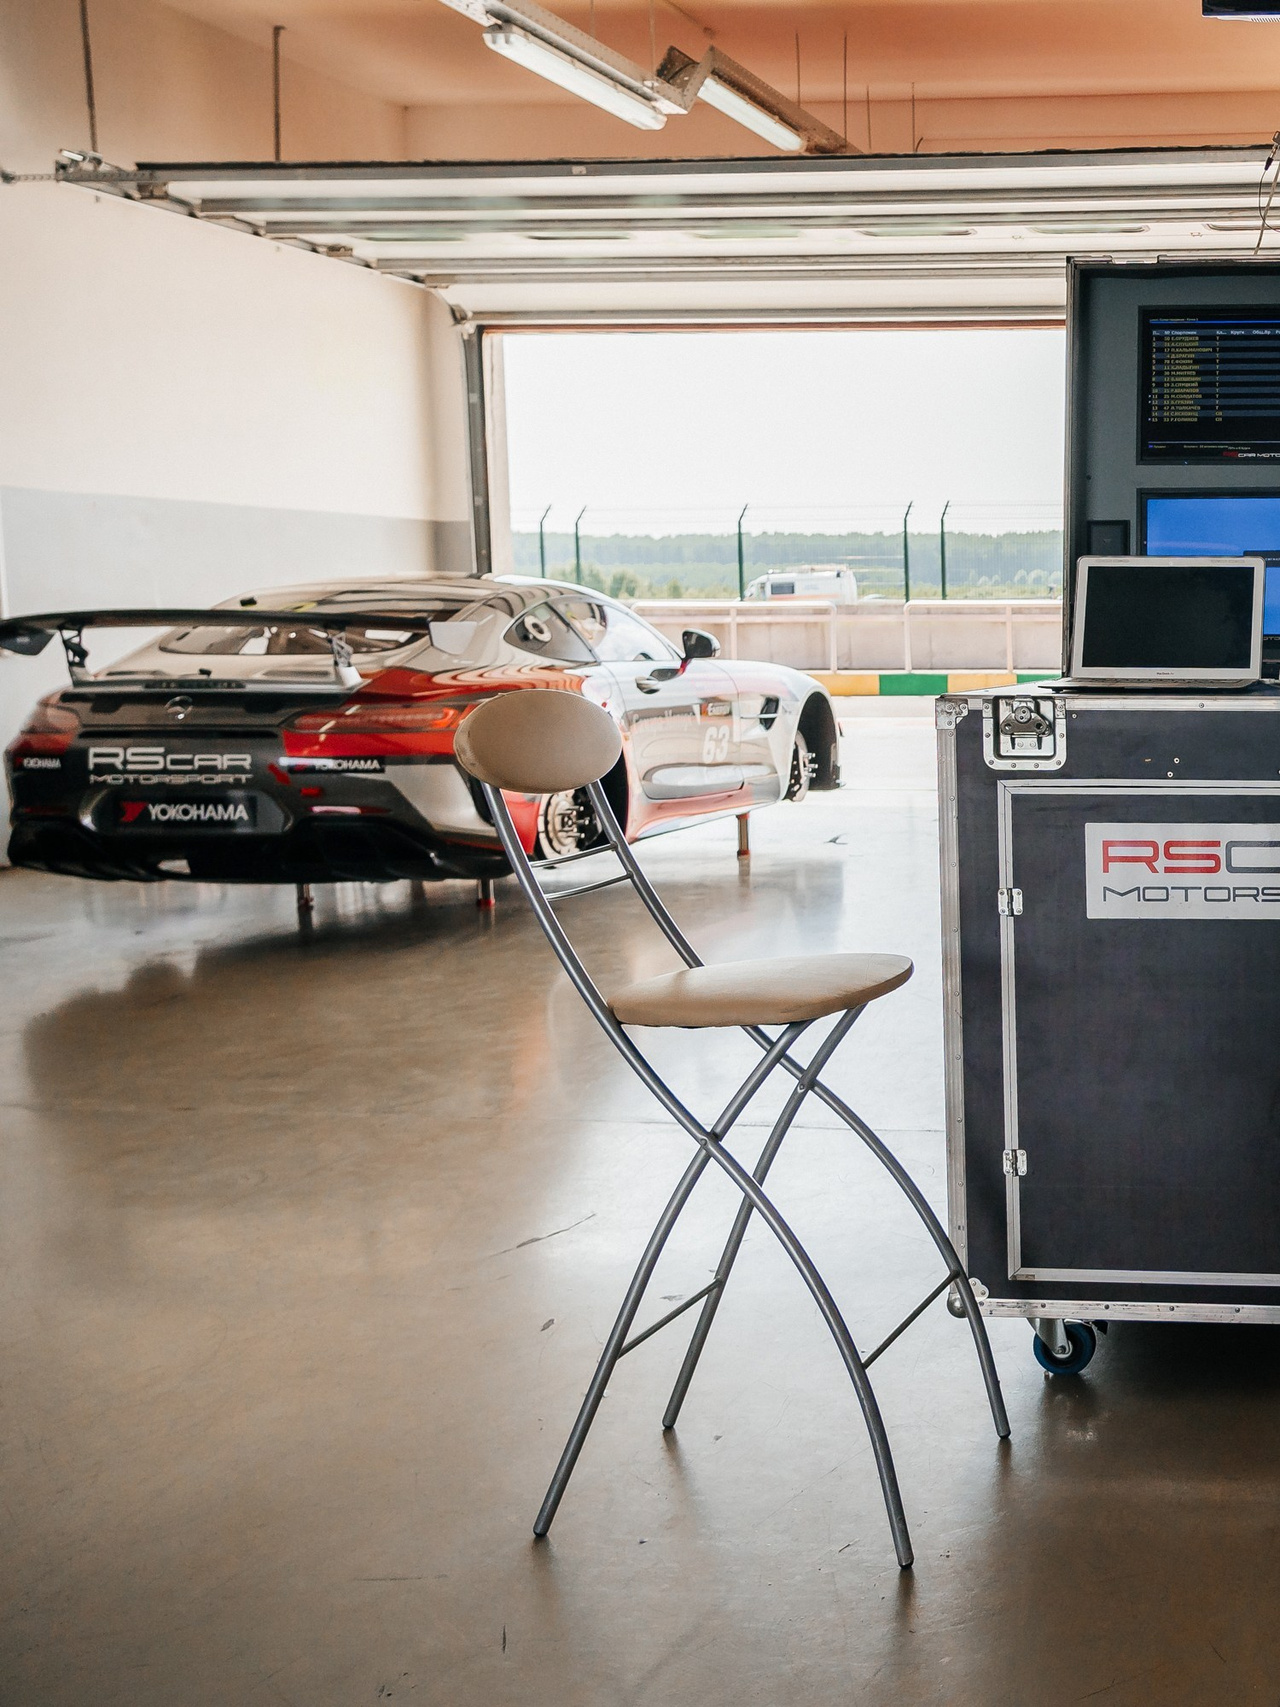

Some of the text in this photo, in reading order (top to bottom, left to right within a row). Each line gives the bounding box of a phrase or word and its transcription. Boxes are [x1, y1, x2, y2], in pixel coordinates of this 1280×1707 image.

[702, 725, 730, 764] 63
[90, 774, 253, 784] MOTORSPORT
[149, 804, 249, 821] YOKOHAMA
